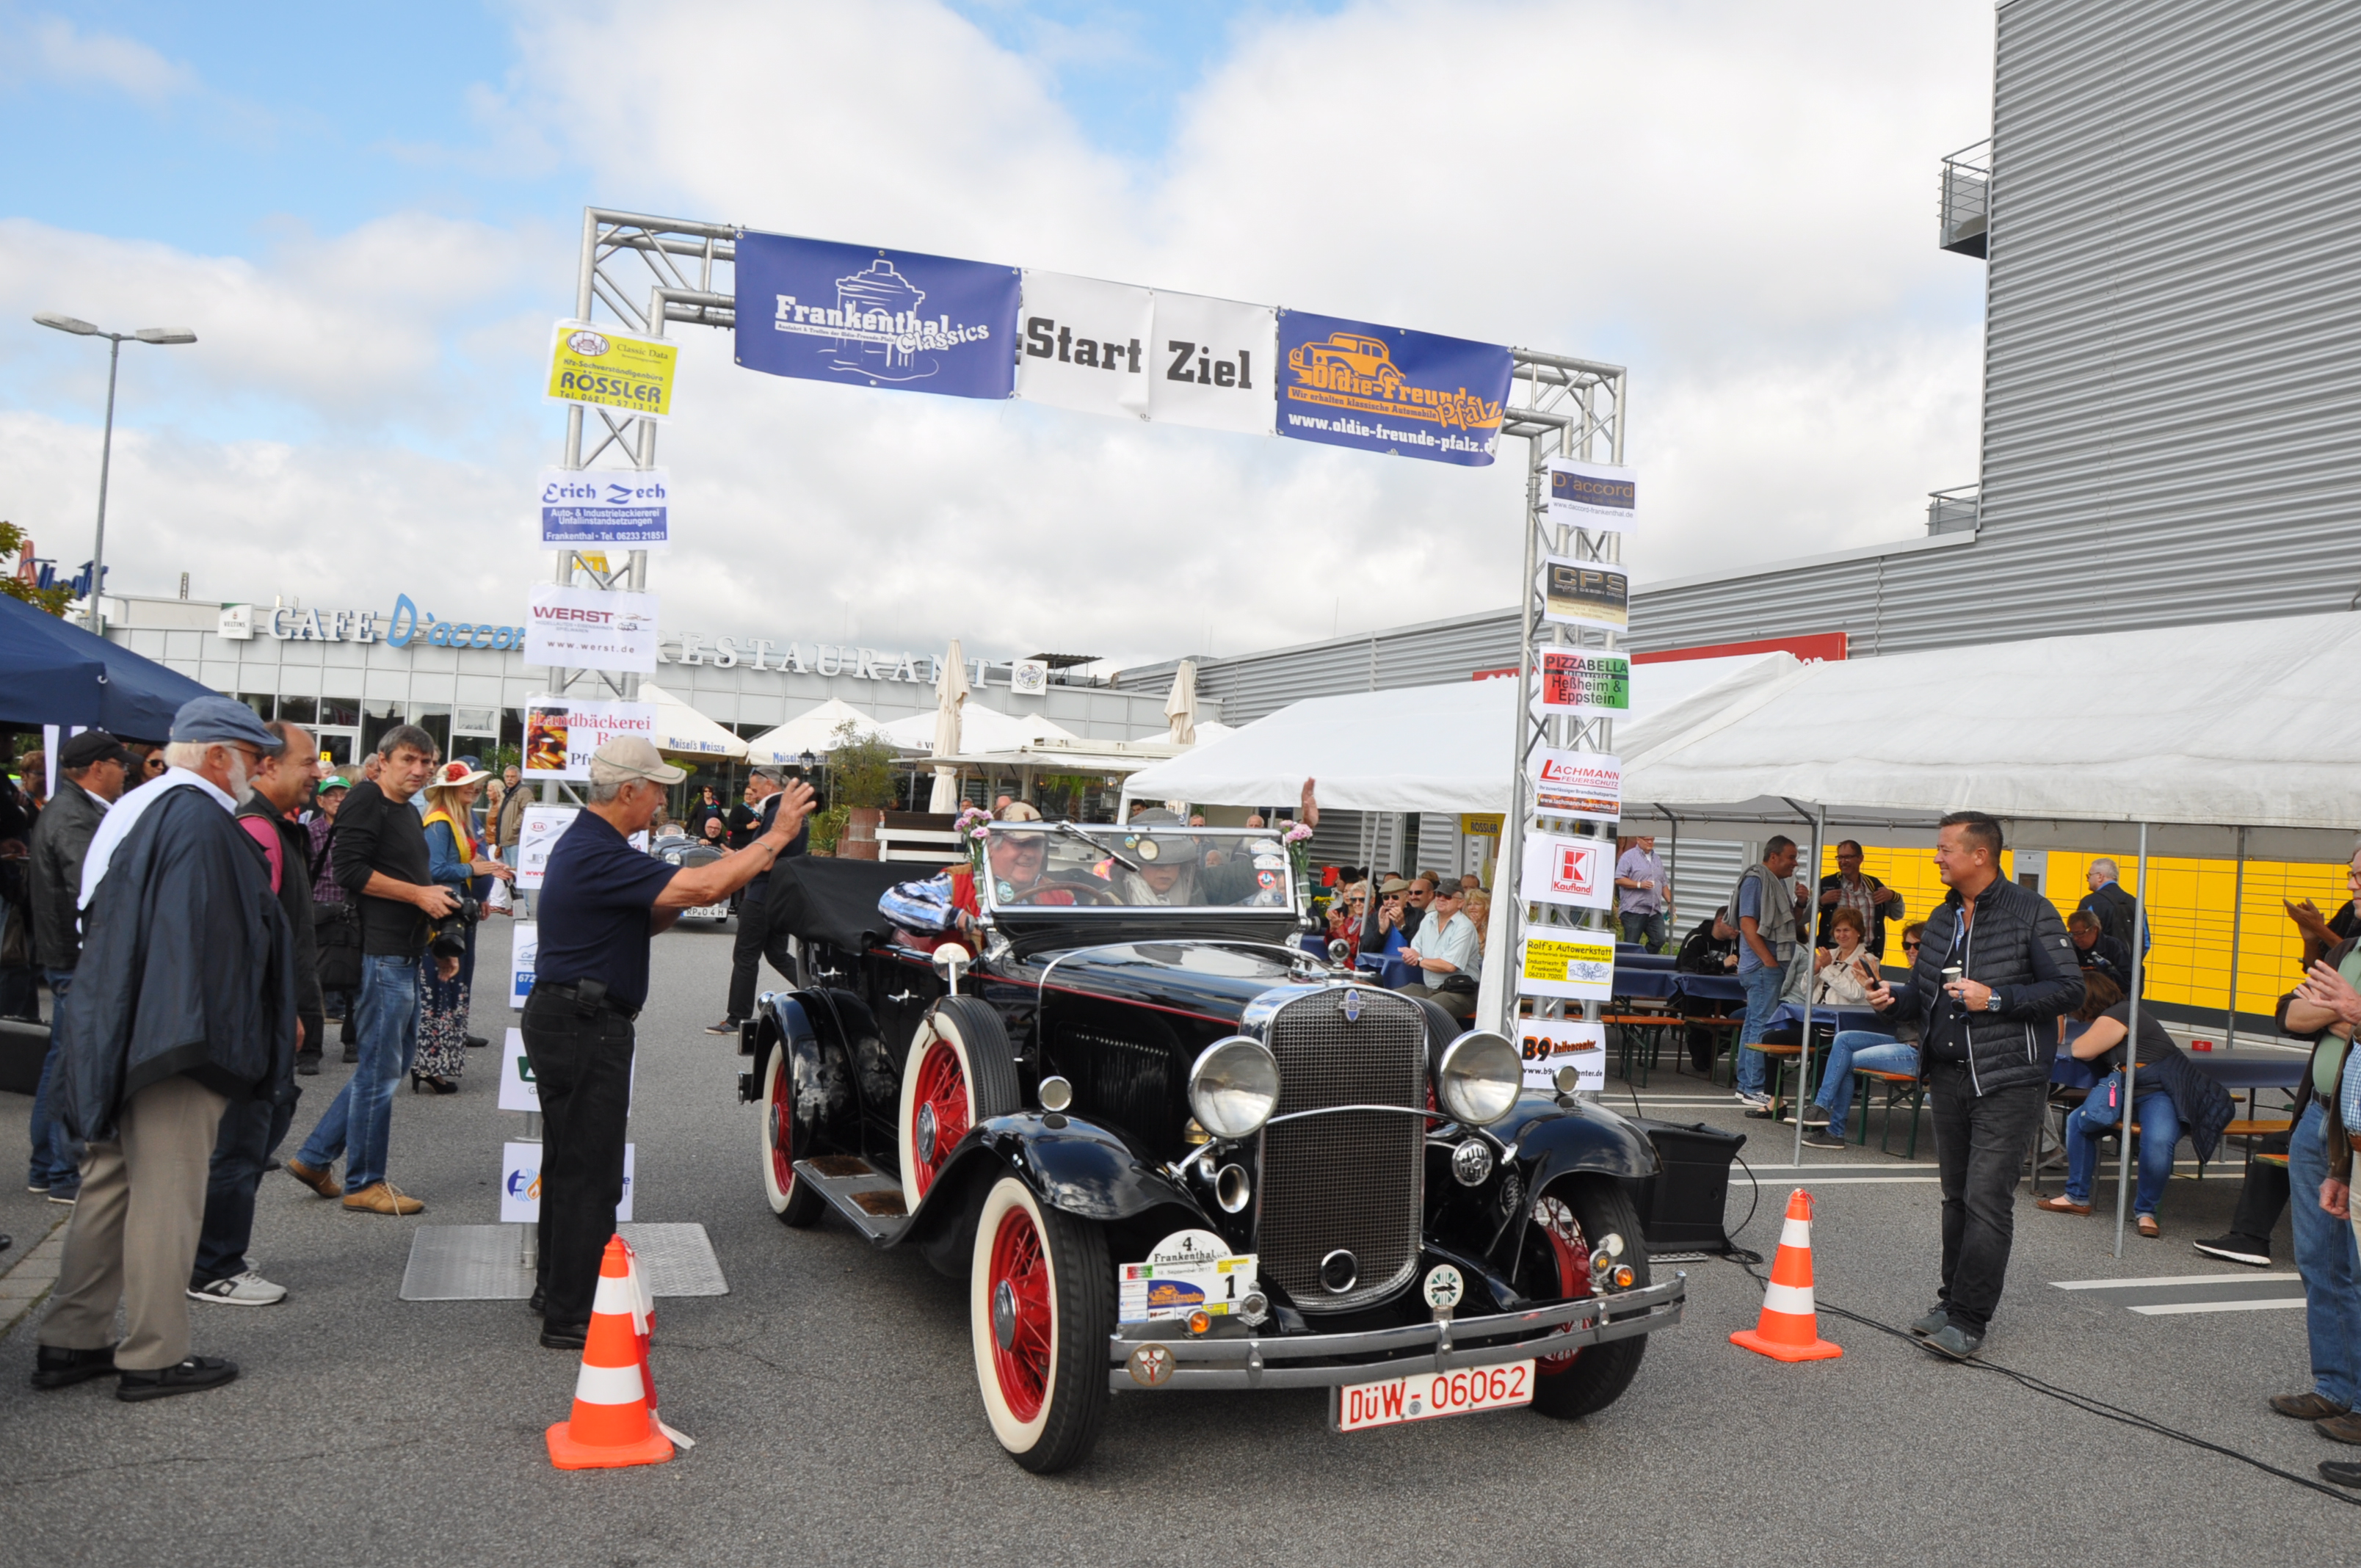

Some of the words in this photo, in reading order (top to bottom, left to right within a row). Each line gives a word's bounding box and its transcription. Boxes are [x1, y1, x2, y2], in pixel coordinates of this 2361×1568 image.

[775, 294, 949, 350] Frankenthal
[896, 324, 989, 354] Classics
[617, 344, 646, 356] Classic
[649, 349, 668, 360] Data
[1026, 316, 1142, 373] Start
[1167, 340, 1252, 389] Ziel
[564, 358, 664, 382] Kfz-Sachverständigenbüro
[560, 370, 661, 404] RÖSSLER
[560, 391, 577, 399] Tel.
[581, 393, 606, 404] 0621
[633, 402, 643, 410] 13
[648, 404, 659, 413] 14
[1291, 388, 1308, 399] Wir
[1310, 392, 1344, 405] erhalten
[1347, 398, 1389, 413] klassische
[1393, 404, 1437, 419] Automobile
[1288, 413, 1493, 452] www.oldie-freunde-pfalz.d
[542, 483, 596, 504] Erich
[606, 483, 665, 504] Zech
[551, 509, 573, 517] Auto-
[576, 509, 581, 517] &
[559, 517, 653, 526] Unfallinstandsetzungen
[546, 532, 594, 540] Frankenthal
[601, 532, 614, 540] Tel.
[617, 531, 640, 540] 06233
[642, 531, 665, 540] 21851
[1554, 567, 1625, 594] CPS
[267, 607, 377, 643] CAFE
[386, 592, 526, 650] D'accor
[533, 606, 614, 623] WERST
[1546, 656, 1628, 674] PIZZABELLA
[1564, 670, 1612, 679] Heimservice
[1552, 676, 1609, 692] Heßheim
[1613, 680, 1622, 692] &
[1559, 689, 1615, 705] Eppstein
[533, 710, 650, 730] Landbäckerei
[669, 738, 697, 750] Maisel's
[700, 741, 725, 753] Weisse
[1540, 759, 1620, 780] LACHMANN
[1562, 776, 1619, 787] FEUERSCHUTZ
[1553, 881, 1591, 893] Kaufland
[1528, 940, 1552, 951] Rolf's
[1556, 944, 1611, 956] Autowerkstatt
[1527, 958, 1559, 966] Industriestr
[1522, 1036, 1553, 1061] B9
[1553, 1039, 1596, 1053] Reifencenter
[1182, 1237, 1197, 1252] 4.
[1154, 1249, 1214, 1263] Frankenthal
[1225, 1274, 1235, 1299] 1
